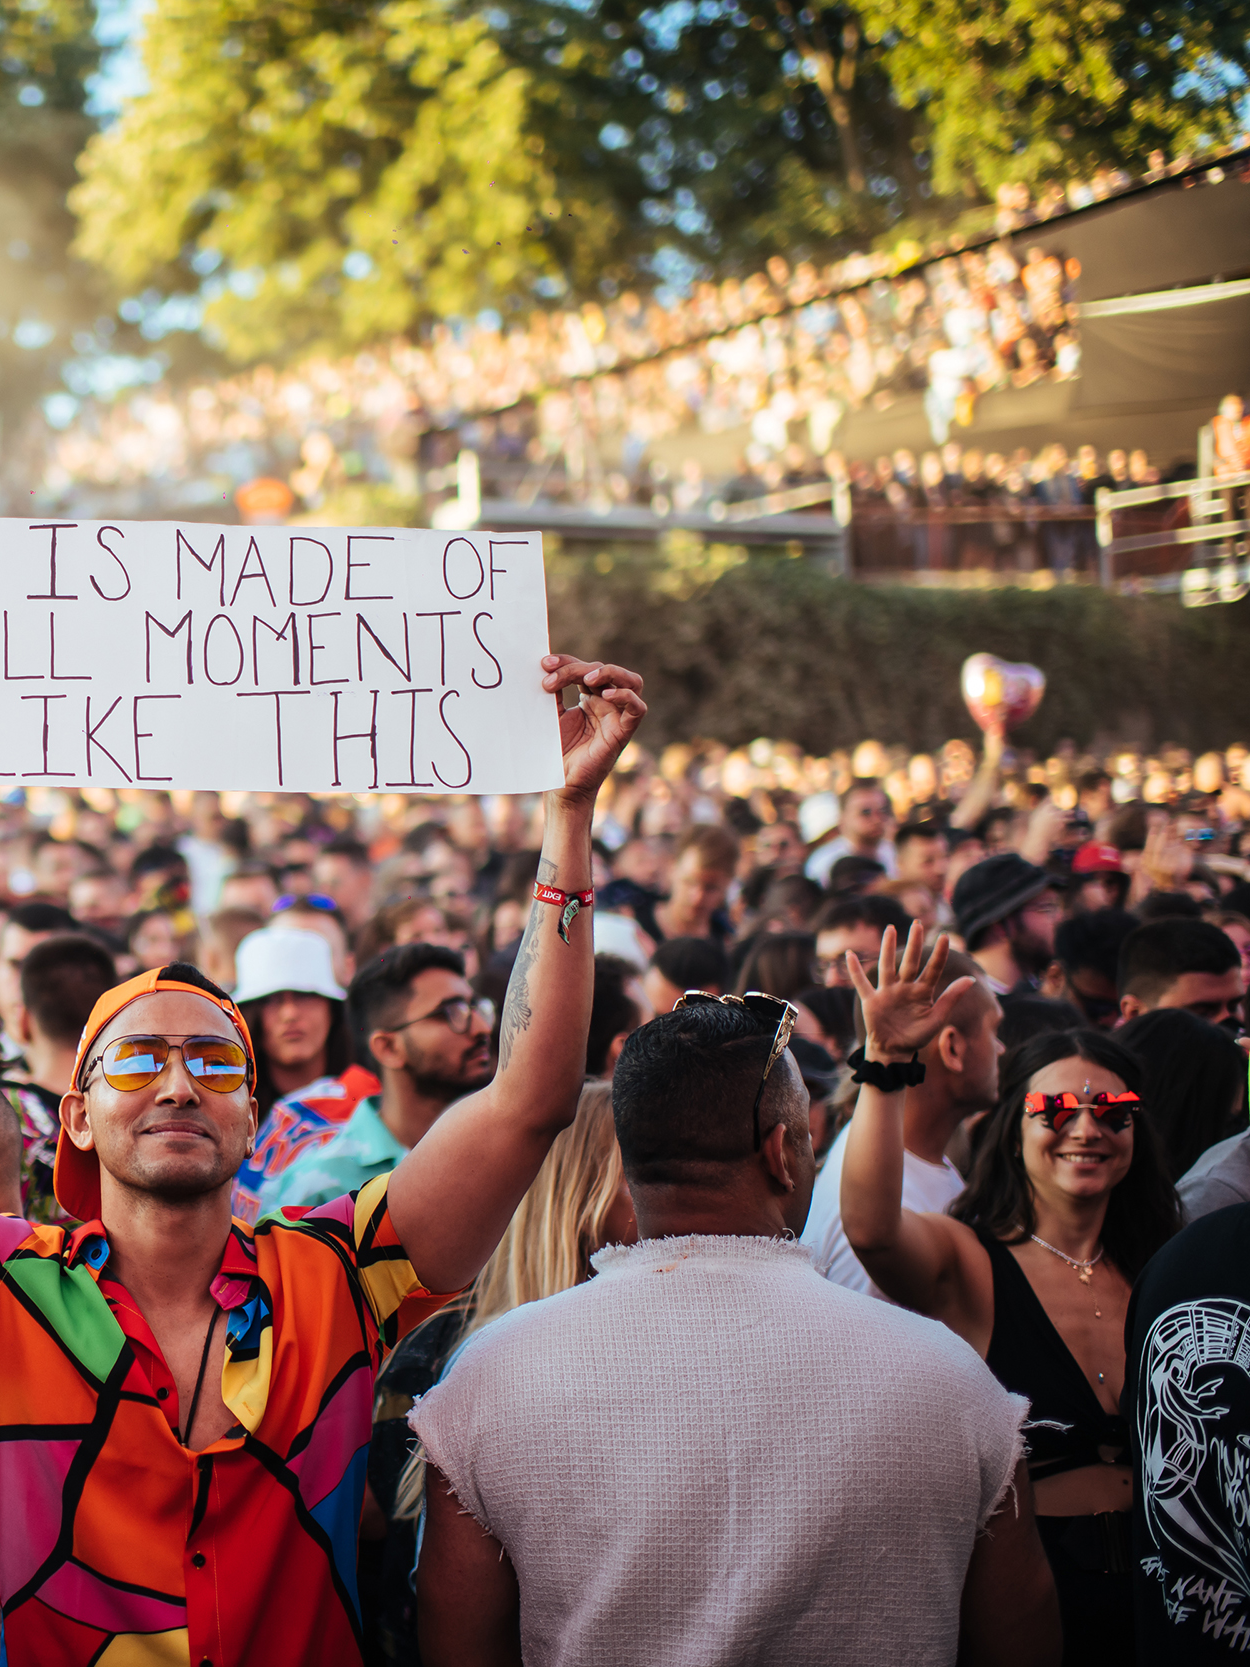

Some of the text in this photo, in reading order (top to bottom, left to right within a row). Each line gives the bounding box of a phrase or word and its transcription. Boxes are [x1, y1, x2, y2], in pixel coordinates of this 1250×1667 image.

[27, 522, 132, 601] IS
[176, 528, 396, 607] MADE
[442, 537, 530, 600] OF
[145, 609, 503, 690] MOMENTS
[236, 687, 473, 790] THIS
[542, 890, 562, 901] EXIT
